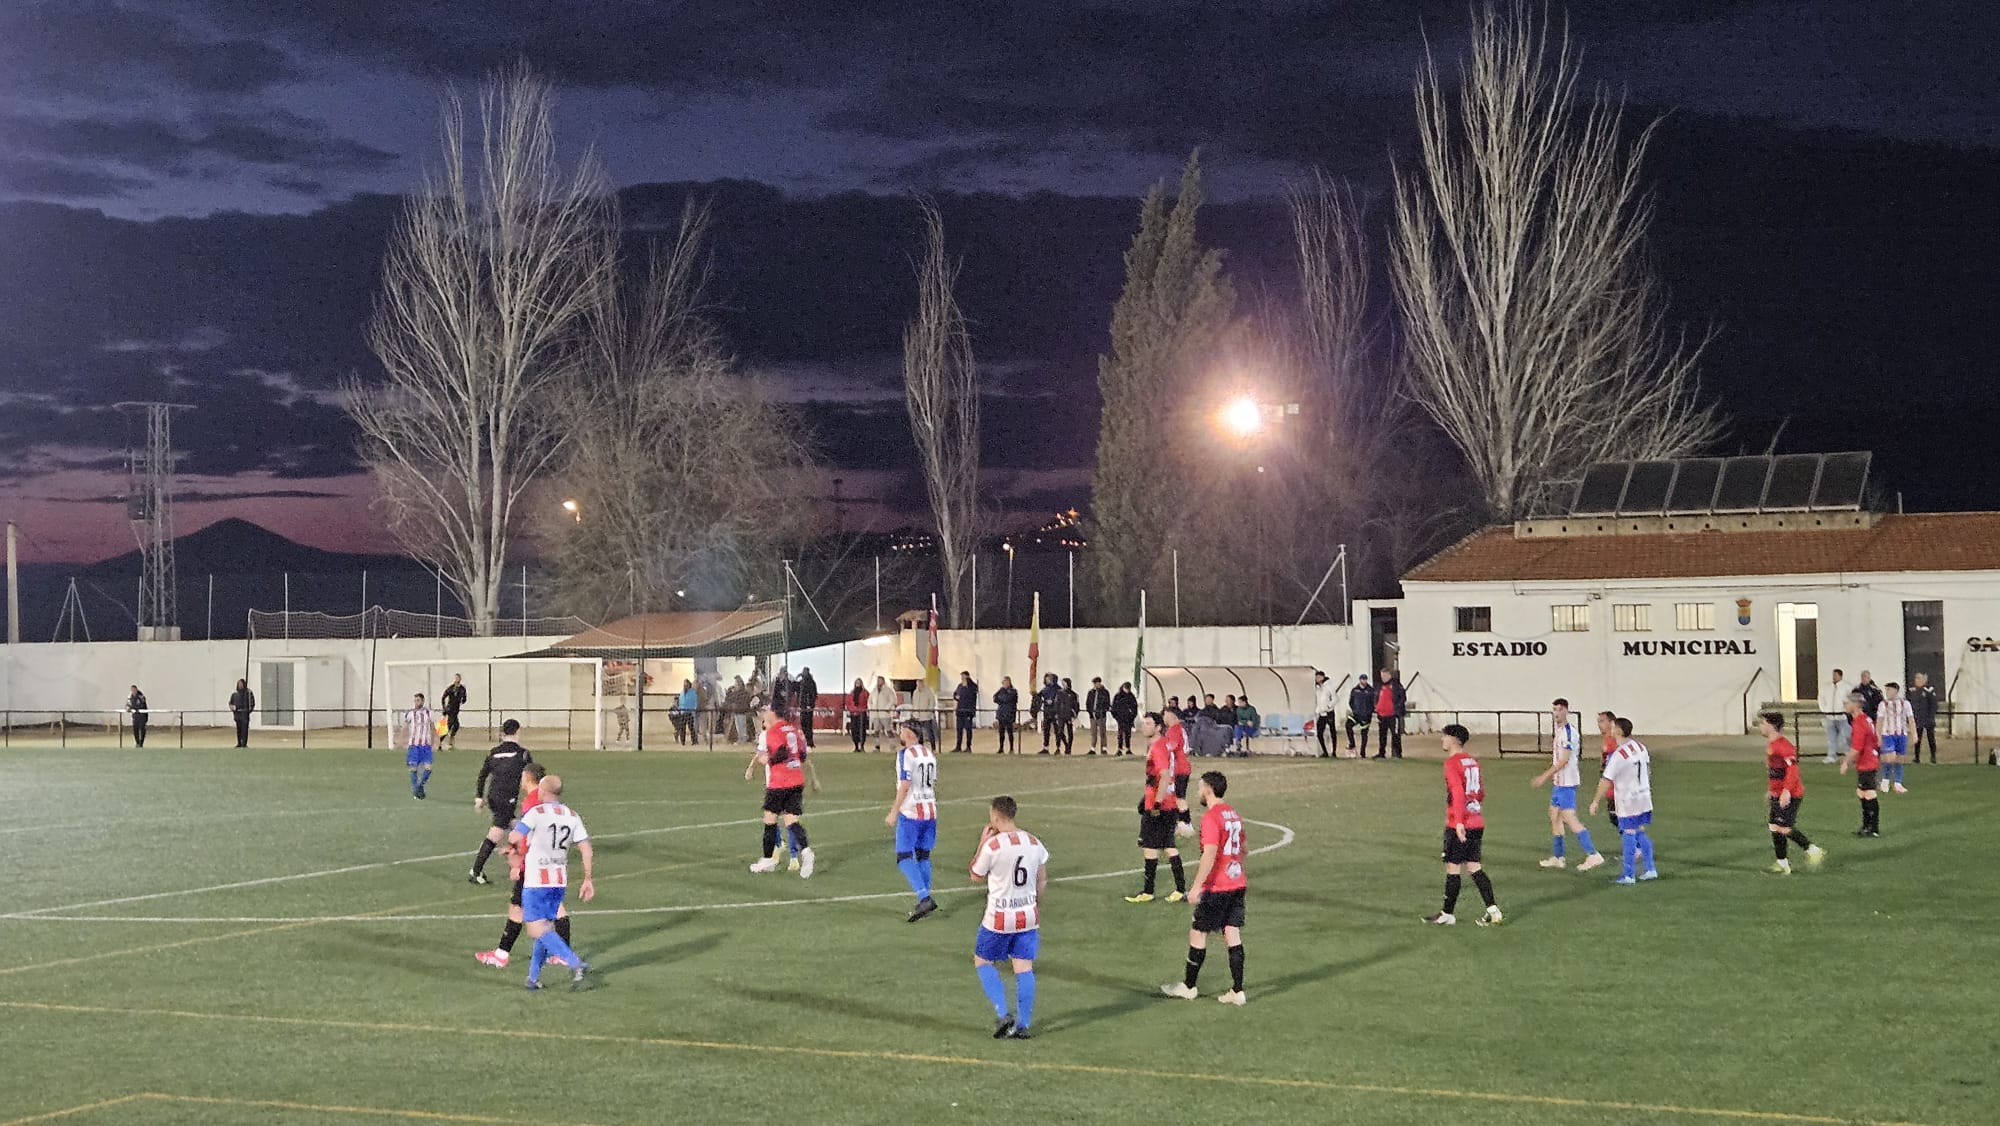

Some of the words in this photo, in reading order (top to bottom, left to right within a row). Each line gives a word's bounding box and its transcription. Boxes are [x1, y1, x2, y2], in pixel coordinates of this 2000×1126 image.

[1452, 641, 1548, 656] ESTADIO
[1622, 639, 1757, 656] MUNICIPAL
[918, 762, 934, 788] 10
[548, 822, 571, 850] 12
[1014, 855, 1028, 887] 6
